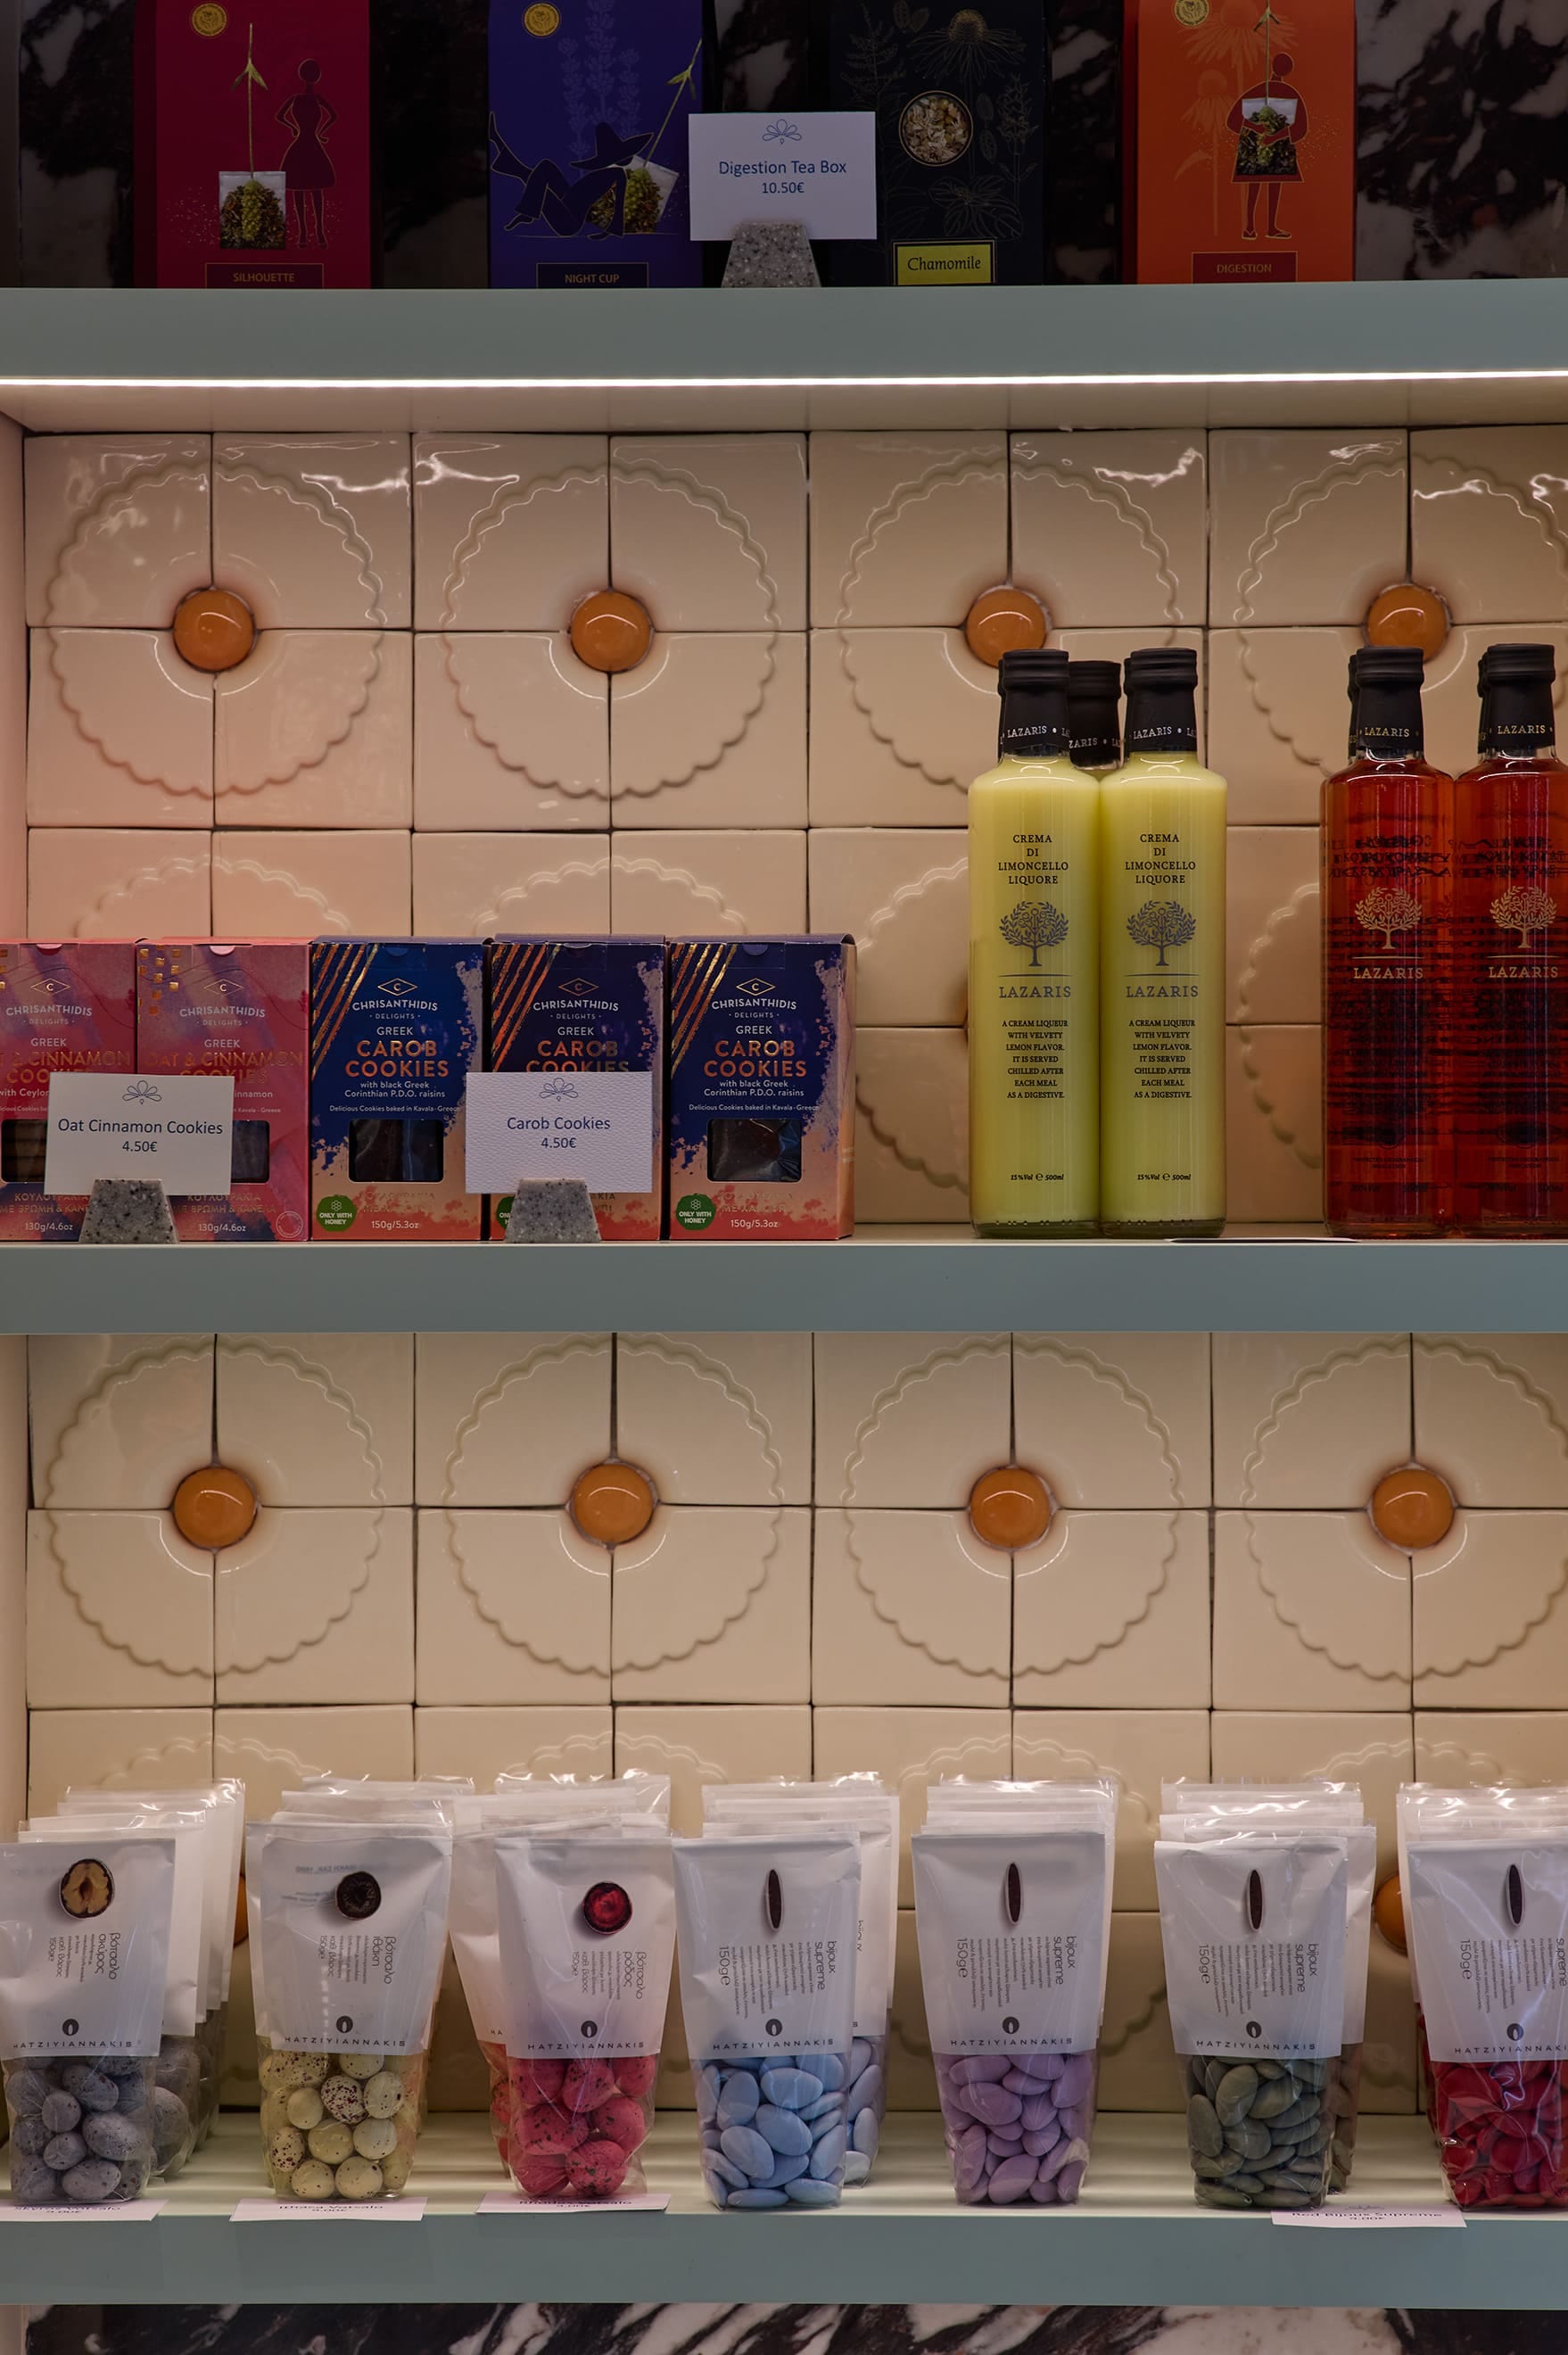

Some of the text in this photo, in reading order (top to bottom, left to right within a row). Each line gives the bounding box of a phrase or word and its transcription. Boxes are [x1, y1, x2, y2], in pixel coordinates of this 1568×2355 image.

[719, 160, 847, 177] Digestion Tea Box
[762, 182, 805, 194] 10.50€
[907, 255, 981, 271] Chamomile
[1216, 263, 1272, 274] DIGESTION
[233, 272, 295, 283] SILHOUETTE
[565, 273, 620, 284] NIGHT CUP
[1007, 725, 1047, 738] LAZARIS
[1133, 726, 1172, 740] LAZARIS
[1365, 727, 1410, 738] LAZARIS
[1498, 724, 1546, 735] LAZARIS
[1069, 737, 1098, 749] ZARIS
[1012, 834, 1052, 843] CREMA
[1140, 834, 1180, 843] CREMA
[1026, 848, 1039, 856] DI
[1153, 847, 1166, 856] DI
[998, 862, 1069, 871] LIMONCELLO
[1125, 861, 1196, 870] LIMONCELLO
[1008, 875, 1059, 885] LIQUORE
[1135, 875, 1185, 885] LIQUORE
[1353, 967, 1424, 979] LAZARIS
[1488, 966, 1559, 979] LAZARIS
[999, 986, 1071, 998] LAZARIS
[1126, 985, 1199, 997] LAZARIS
[5, 1004, 93, 1016] CHRISANTHIDIS
[351, 999, 439, 1012] CHRISANTHIDIS
[532, 999, 619, 1012] CHRISANTHIDIS
[711, 998, 797, 1011] CHRISANTHIDIS
[179, 1006, 266, 1018] CHRISANTHIDIS
[735, 1025, 772, 1035] GREEK
[1036, 1020, 1069, 1028] LIQUEUR
[1162, 1020, 1195, 1028] LIQUEUR
[376, 1026, 414, 1036] GREEK
[557, 1026, 595, 1036] GREEK
[30, 1037, 67, 1047] GREEK
[204, 1038, 241, 1048] GREEK
[356, 1040, 438, 1057] CAROB
[537, 1040, 618, 1057] CAROB
[714, 1040, 796, 1057] CAROB
[29, 1051, 130, 1066] CINNAMON
[201, 1051, 303, 1067] CINNAMON
[344, 1060, 449, 1078] COOKIES
[525, 1060, 629, 1071] COOKIES
[703, 1060, 807, 1078] COOKIES
[1008, 1067, 1064, 1075] CHILLED AFTER
[1135, 1067, 1191, 1075] CHILLED AFTER
[404, 1080, 430, 1088] Greek
[719, 1079, 788, 1087] with black Greek
[235, 1090, 273, 1098] innamon
[344, 1089, 446, 1097] Corinthian P.D.O. raisins
[704, 1088, 805, 1096] Corinthian P.D.O. raisins
[58, 1119, 223, 1135] Oat Cinnamon Cookies
[508, 1117, 610, 1129] Carob Cookies
[122, 1140, 158, 1153] 4.50€
[541, 1136, 577, 1149] 4.50€
[25, 1222, 73, 1232] 130g/4.6oz
[198, 1222, 247, 1233] 130g/4.6oz
[371, 1220, 419, 1231] 150g/5.3oz
[730, 1219, 778, 1229] 150g/5.3oz
[95, 1933, 106, 1974] σκύρος
[108, 1932, 120, 1980] βότσαλο
[371, 1936, 384, 1967] ιθάκη
[827, 1940, 837, 1973] bijoux
[1066, 1936, 1077, 1969] bijoux
[384, 1936, 397, 1984] βότσαλο
[814, 1941, 825, 1990] supreme
[1053, 1936, 1063, 1985] supreme
[1308, 1943, 1319, 1976] bijoux
[1556, 1938, 1567, 1987] supreme
[623, 1951, 635, 1987] ρόδος
[1295, 1944, 1306, 1993] supreme
[635, 1951, 647, 1999] βότσαλο
[13, 2040, 132, 2048] HATZIYIANNAKIS
[285, 2037, 406, 2046] HATZIYIANNAKIS
[527, 2042, 644, 2050] HATZIYIANNAKIS
[713, 2038, 834, 2050] HATZIYIANNAKIS
[950, 2037, 1072, 2045] HATZIYIANNAKIS
[1196, 2040, 1316, 2050] HATZIYIANNAKIS
[1455, 2045, 1568, 2053] HATZIYIANNAKI
